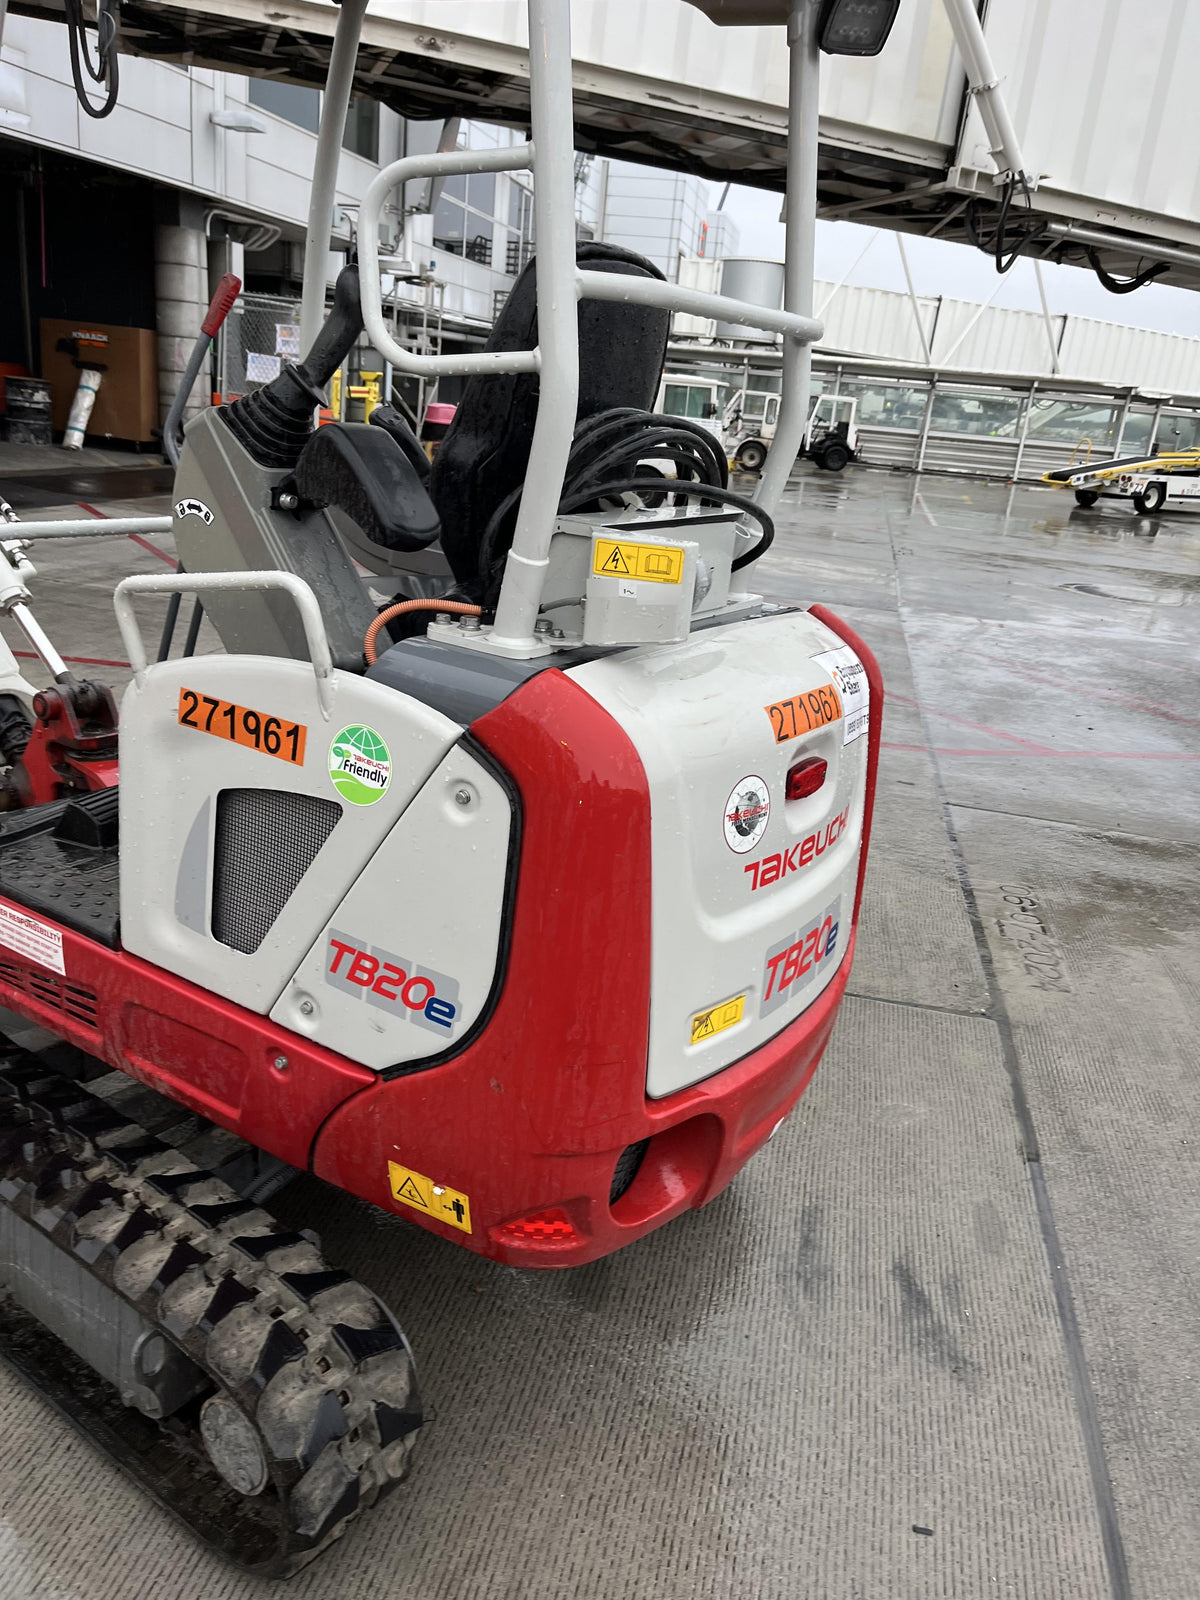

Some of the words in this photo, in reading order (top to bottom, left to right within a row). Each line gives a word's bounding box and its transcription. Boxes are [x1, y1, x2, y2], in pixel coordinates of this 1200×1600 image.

[180, 690, 300, 762] 271961
[769, 686, 840, 742] 271961
[343, 758, 388, 787] Friendly
[353, 753, 390, 773] TAKEUCHI
[726, 802, 769, 822] TAKEUCHI
[743, 803, 850, 891] TAKEUCHI
[8, 912, 61, 943] RESPONSIBILITY
[329, 938, 456, 1028] TB20e
[763, 914, 839, 1002] TB20e
